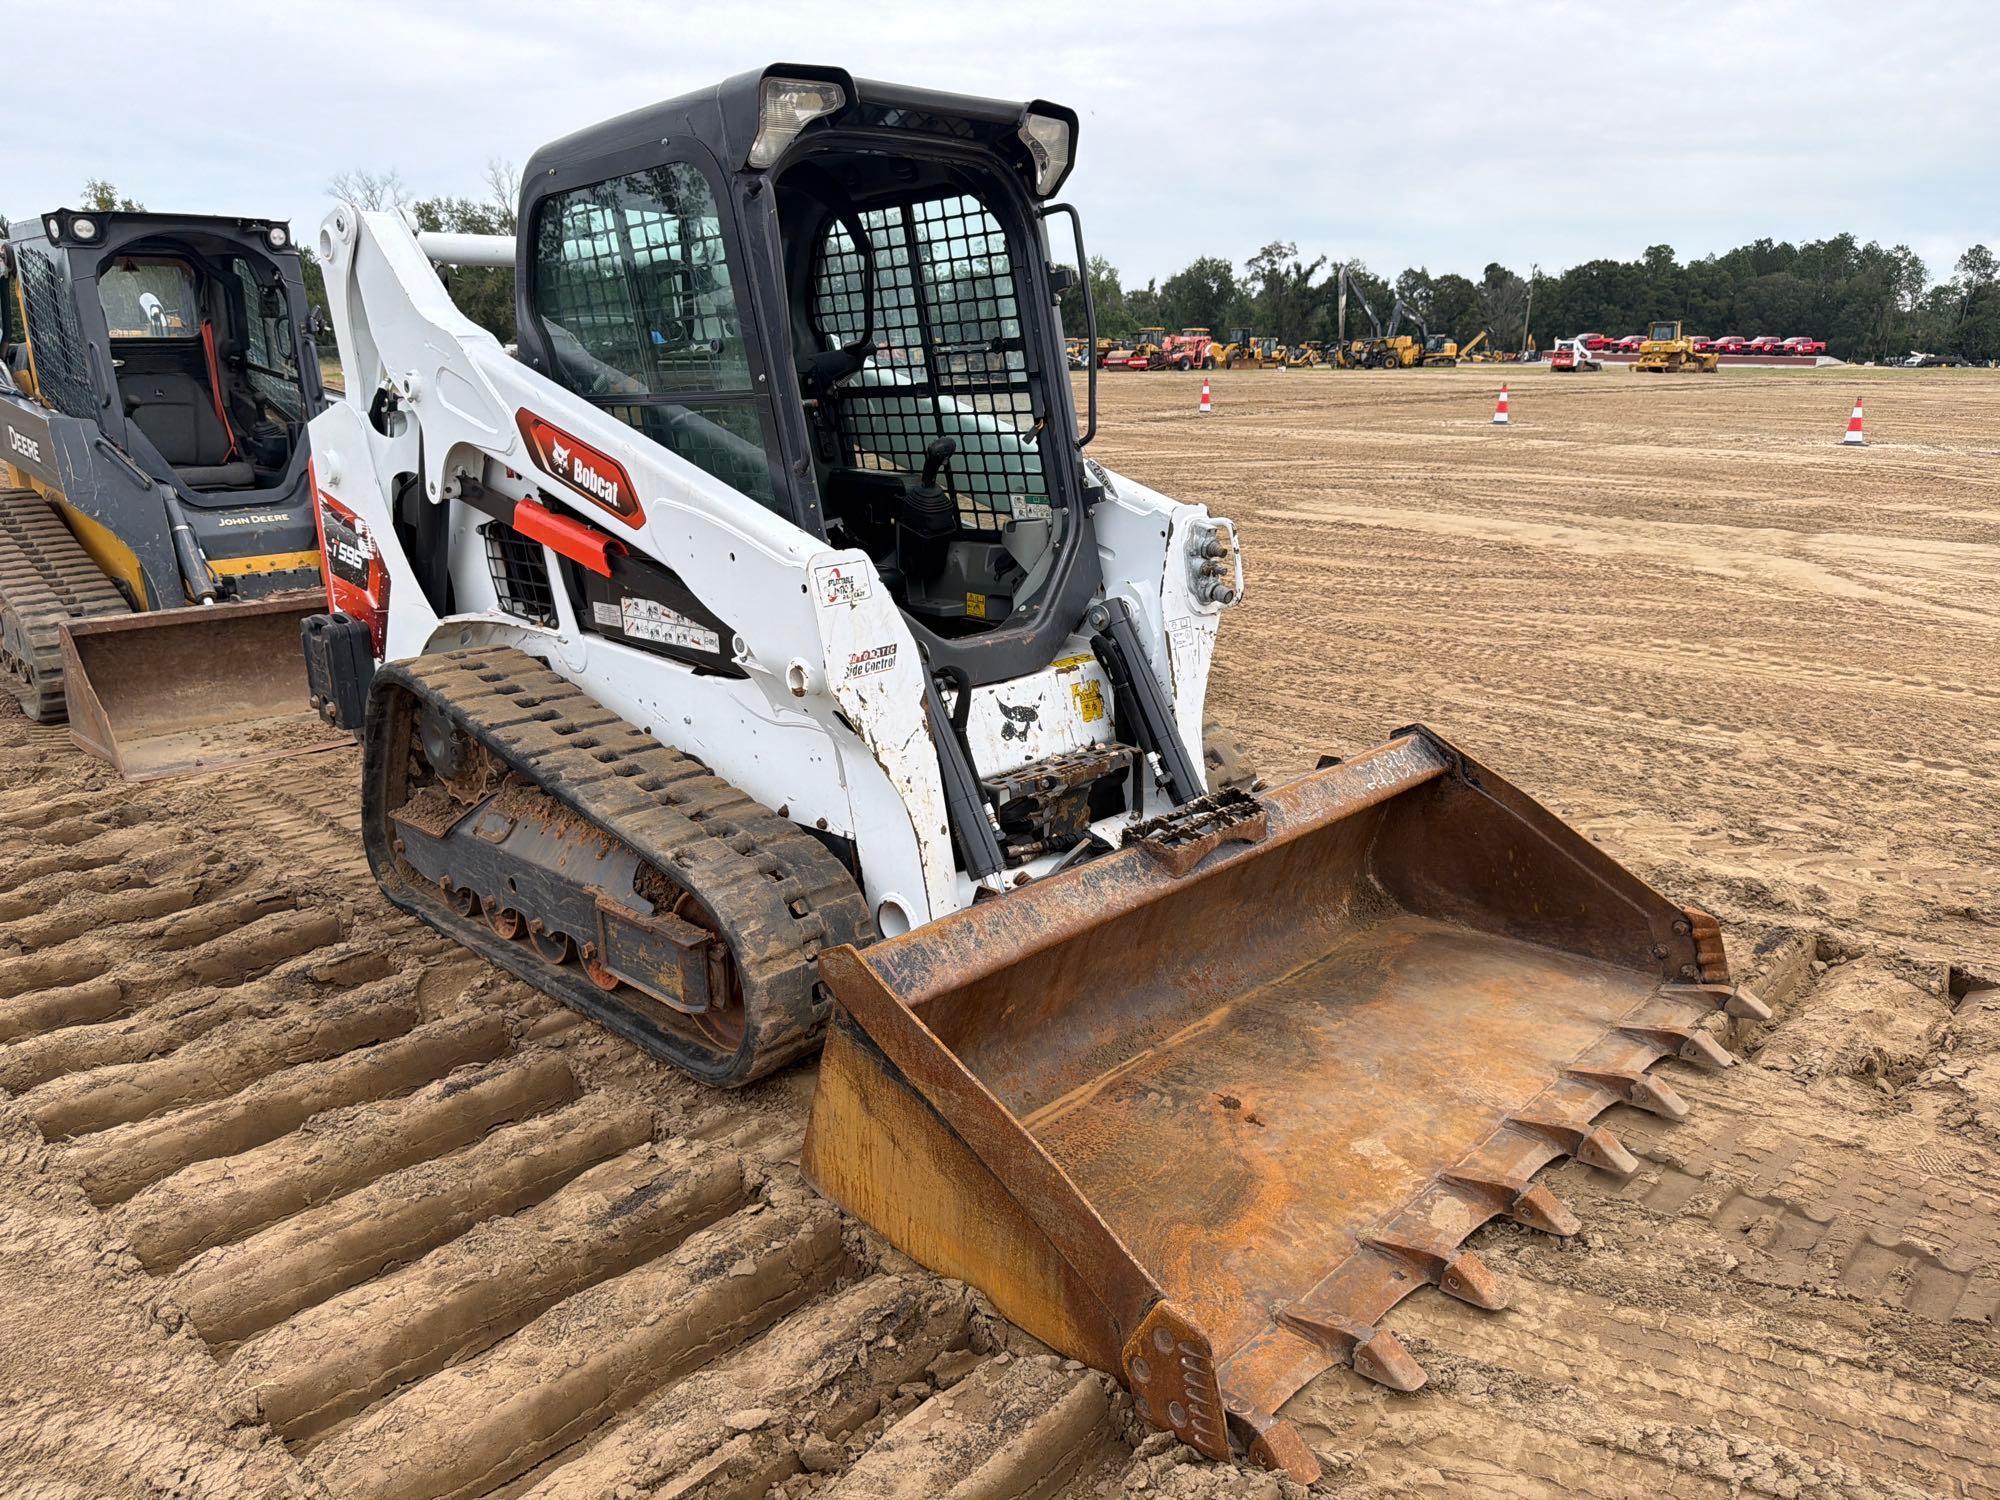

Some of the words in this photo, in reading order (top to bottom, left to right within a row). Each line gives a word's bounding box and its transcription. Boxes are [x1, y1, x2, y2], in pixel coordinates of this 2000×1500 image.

[8, 425, 41, 463] DEERE
[573, 457, 618, 507] Bobcat
[218, 517, 250, 527] JOHN
[250, 514, 290, 523] DEERE
[864, 655, 896, 673] Control
